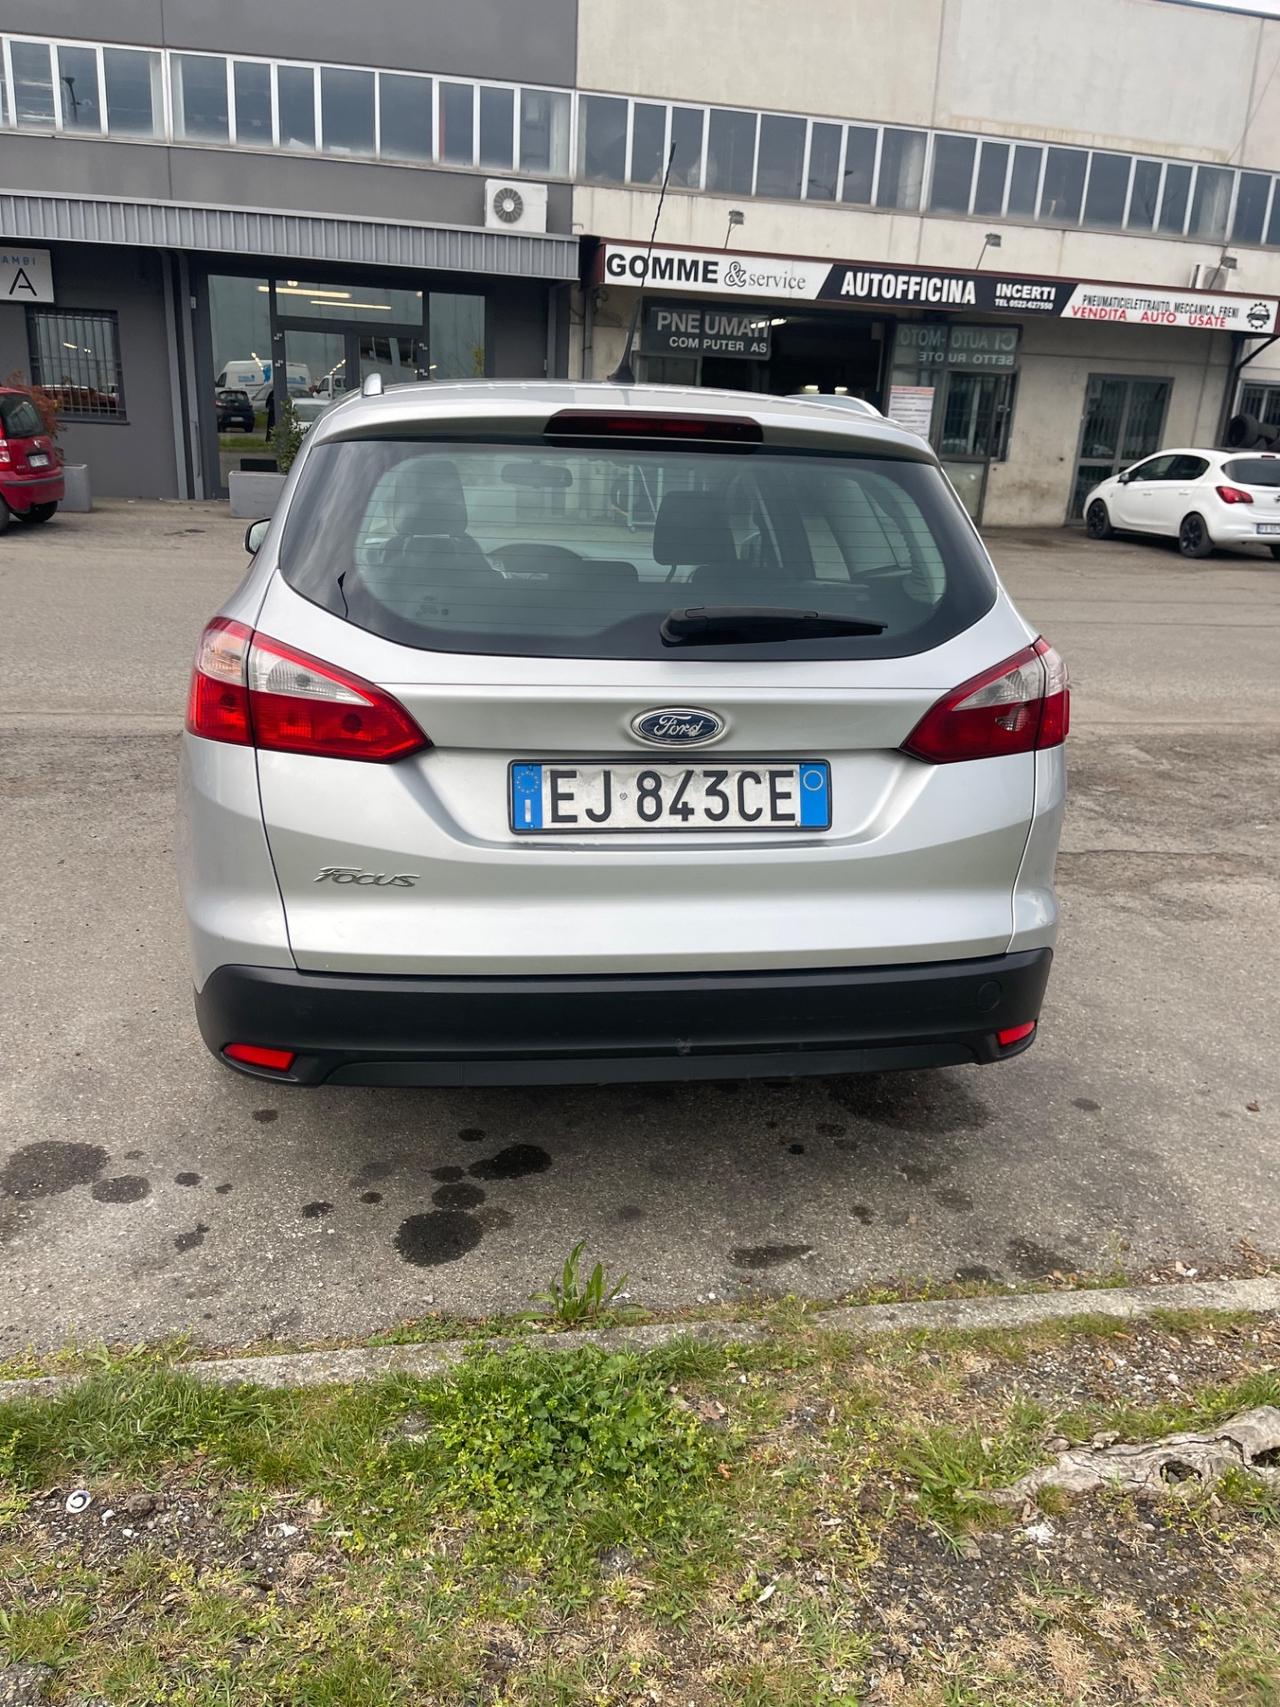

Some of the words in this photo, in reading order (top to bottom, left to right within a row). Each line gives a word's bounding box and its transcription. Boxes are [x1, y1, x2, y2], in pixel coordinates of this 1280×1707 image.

[606, 253, 719, 284] GOMME
[748, 271, 806, 290] service
[840, 271, 976, 304] AUTOFFICINA
[995, 282, 1056, 301] INCERTI
[994, 298, 1008, 307] TEL
[1219, 305, 1240, 319] FRENI
[1071, 304, 1128, 321] VENDITA
[1141, 312, 1177, 324] AUTO
[1188, 315, 1227, 328] USATE
[750, 342, 767, 353] AS
[653, 714, 703, 738] Ford
[550, 770, 612, 823] EJ
